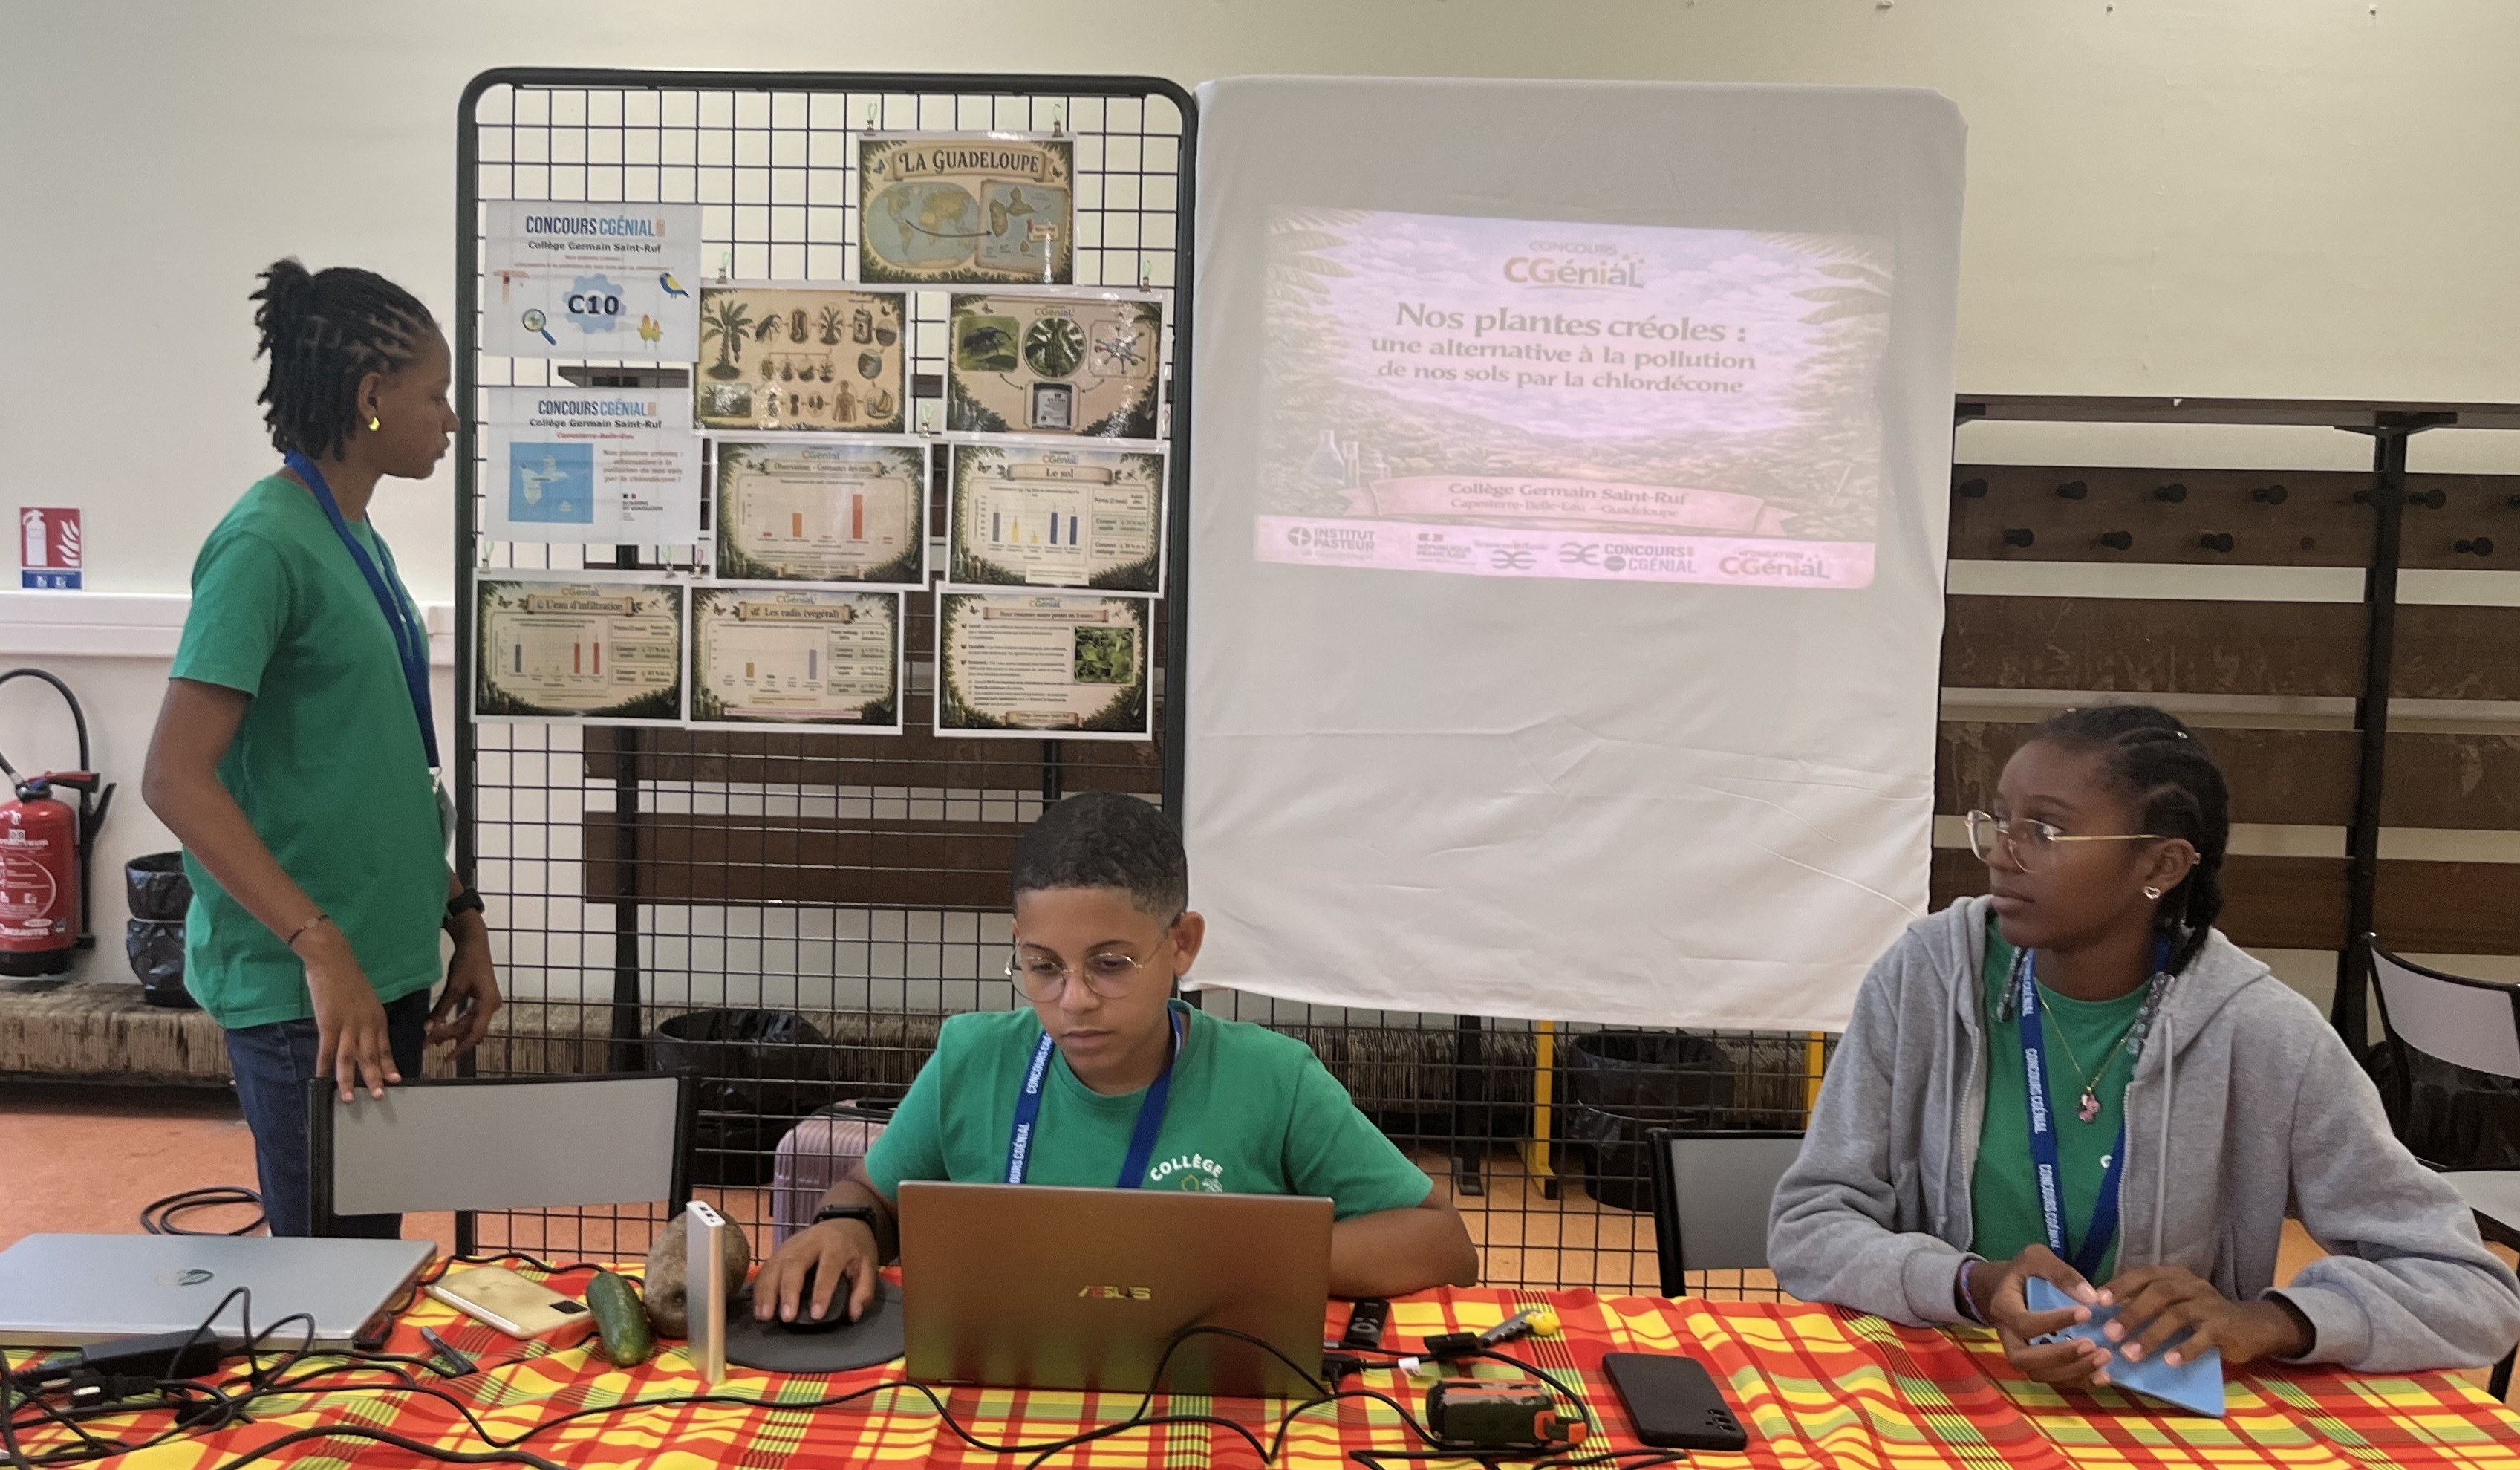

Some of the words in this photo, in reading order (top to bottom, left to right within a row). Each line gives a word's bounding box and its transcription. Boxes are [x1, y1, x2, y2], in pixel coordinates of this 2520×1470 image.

[899, 152, 927, 172] LA
[526, 215, 597, 235] CONCOURS
[599, 215, 656, 237] CGÉNIAL
[528, 240, 565, 251] Collège
[568, 241, 611, 252] Germain
[613, 243, 661, 253] Saint-Ruf
[1529, 240, 1618, 256] CONCOURS
[567, 294, 619, 316] C10
[1396, 302, 1465, 329] Nos
[1475, 307, 1601, 337] plantes
[1608, 314, 1727, 342] créoles
[1372, 339, 1422, 354] une
[1429, 338, 1572, 362] alternative
[1578, 345, 1593, 363] à
[1604, 346, 1625, 364] la
[1635, 350, 1756, 371] pollution
[1378, 360, 1407, 377] de
[1414, 365, 1458, 381] nos
[1464, 365, 1510, 382] sols
[1517, 371, 1558, 388] par
[1565, 371, 1584, 387] la
[1592, 372, 1744, 393] chlordécone
[538, 400, 598, 416] CONCOURS
[600, 398, 647, 417] CGÉNIAL
[530, 418, 566, 429] Collège
[569, 419, 612, 428] Germain
[615, 420, 662, 429] Saint-Ruf
[1046, 468, 1059, 477] Le
[1061, 469, 1074, 478] sol
[1449, 483, 1514, 498] Collège
[1519, 484, 1596, 499] Germain
[1601, 489, 1690, 504] Saint-Ruf
[1314, 527, 1375, 540] INSTITUT
[1313, 538, 1375, 551] PASTEUR
[1604, 543, 1685, 559] CONCOURS
[1628, 556, 1697, 574] CGÉNIAL
[544, 599, 568, 610] L'eau
[570, 600, 623, 611] d'infiltration
[764, 608, 778, 617] Les
[781, 608, 802, 617] radis
[1009, 1160, 1023, 1184] OURS
[1150, 1153, 1224, 1181] COLLÈGE
